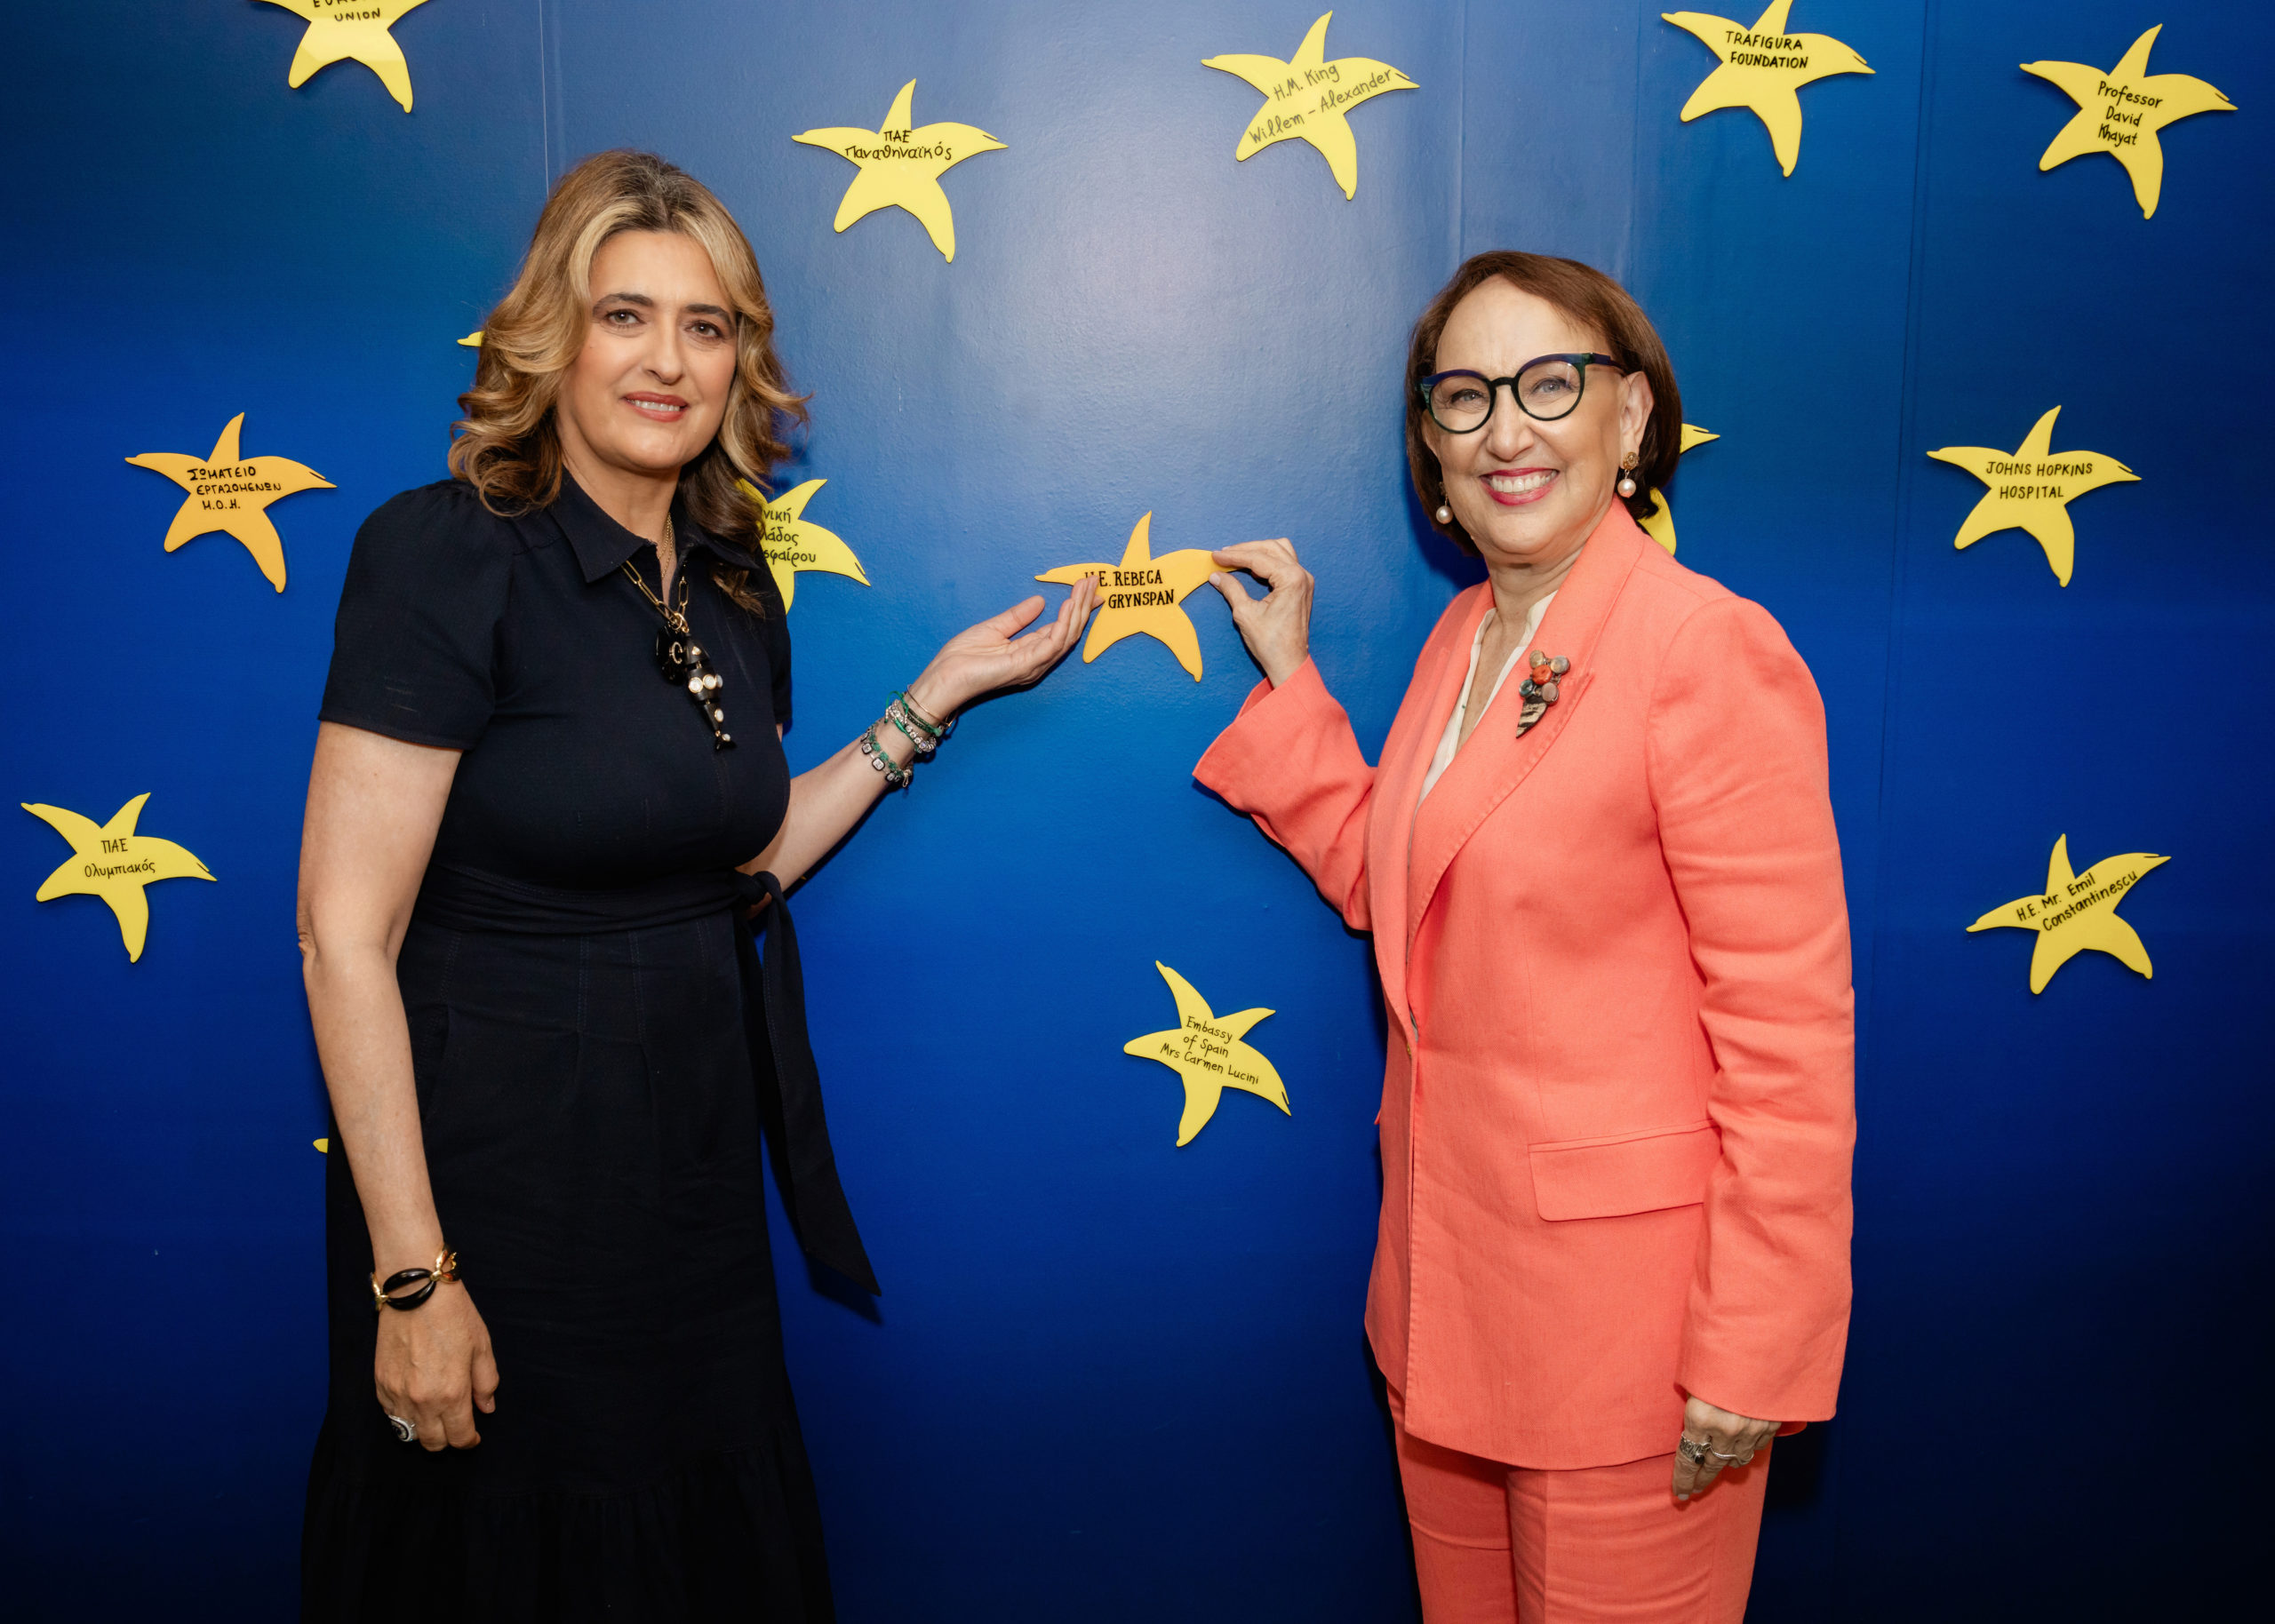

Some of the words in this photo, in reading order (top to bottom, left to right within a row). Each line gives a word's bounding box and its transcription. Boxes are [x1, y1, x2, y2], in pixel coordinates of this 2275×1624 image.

[334, 7, 381, 22] UNION
[1725, 30, 1803, 51] TRAFIGURA
[1730, 51, 1808, 69] FOUNDATION
[1273, 77, 1304, 101] H.M.
[1305, 64, 1340, 87] King
[2097, 80, 2163, 108] Professor
[1249, 114, 1305, 144] Willem
[1320, 68, 1392, 113] Alexander
[2106, 106, 2143, 127] David
[2098, 123, 2138, 147] Khayat
[1986, 461, 2032, 475] JOHNS
[2036, 462, 2093, 477] HOPKINS
[2000, 485, 2064, 499] HOSPITAL
[763, 507, 792, 523] νική
[763, 547, 816, 568] σφαίρου
[1113, 569, 1163, 586] REBECA
[1108, 588, 1174, 609] GRYNSPAN
[84, 858, 156, 880] Ολυμπιακός
[2016, 903, 2040, 921] H.E.
[2041, 894, 2062, 910] Mr.
[2066, 872, 2096, 896] Emil
[2042, 871, 2138, 931] Constantinescu
[1186, 1015, 1233, 1044] Embassy
[1184, 1034, 1199, 1050] of
[1200, 1039, 1229, 1058] Spain
[1160, 1042, 1180, 1059] Mrs
[1184, 1051, 1224, 1074] Carmen
[1227, 1064, 1259, 1085] Lucini
